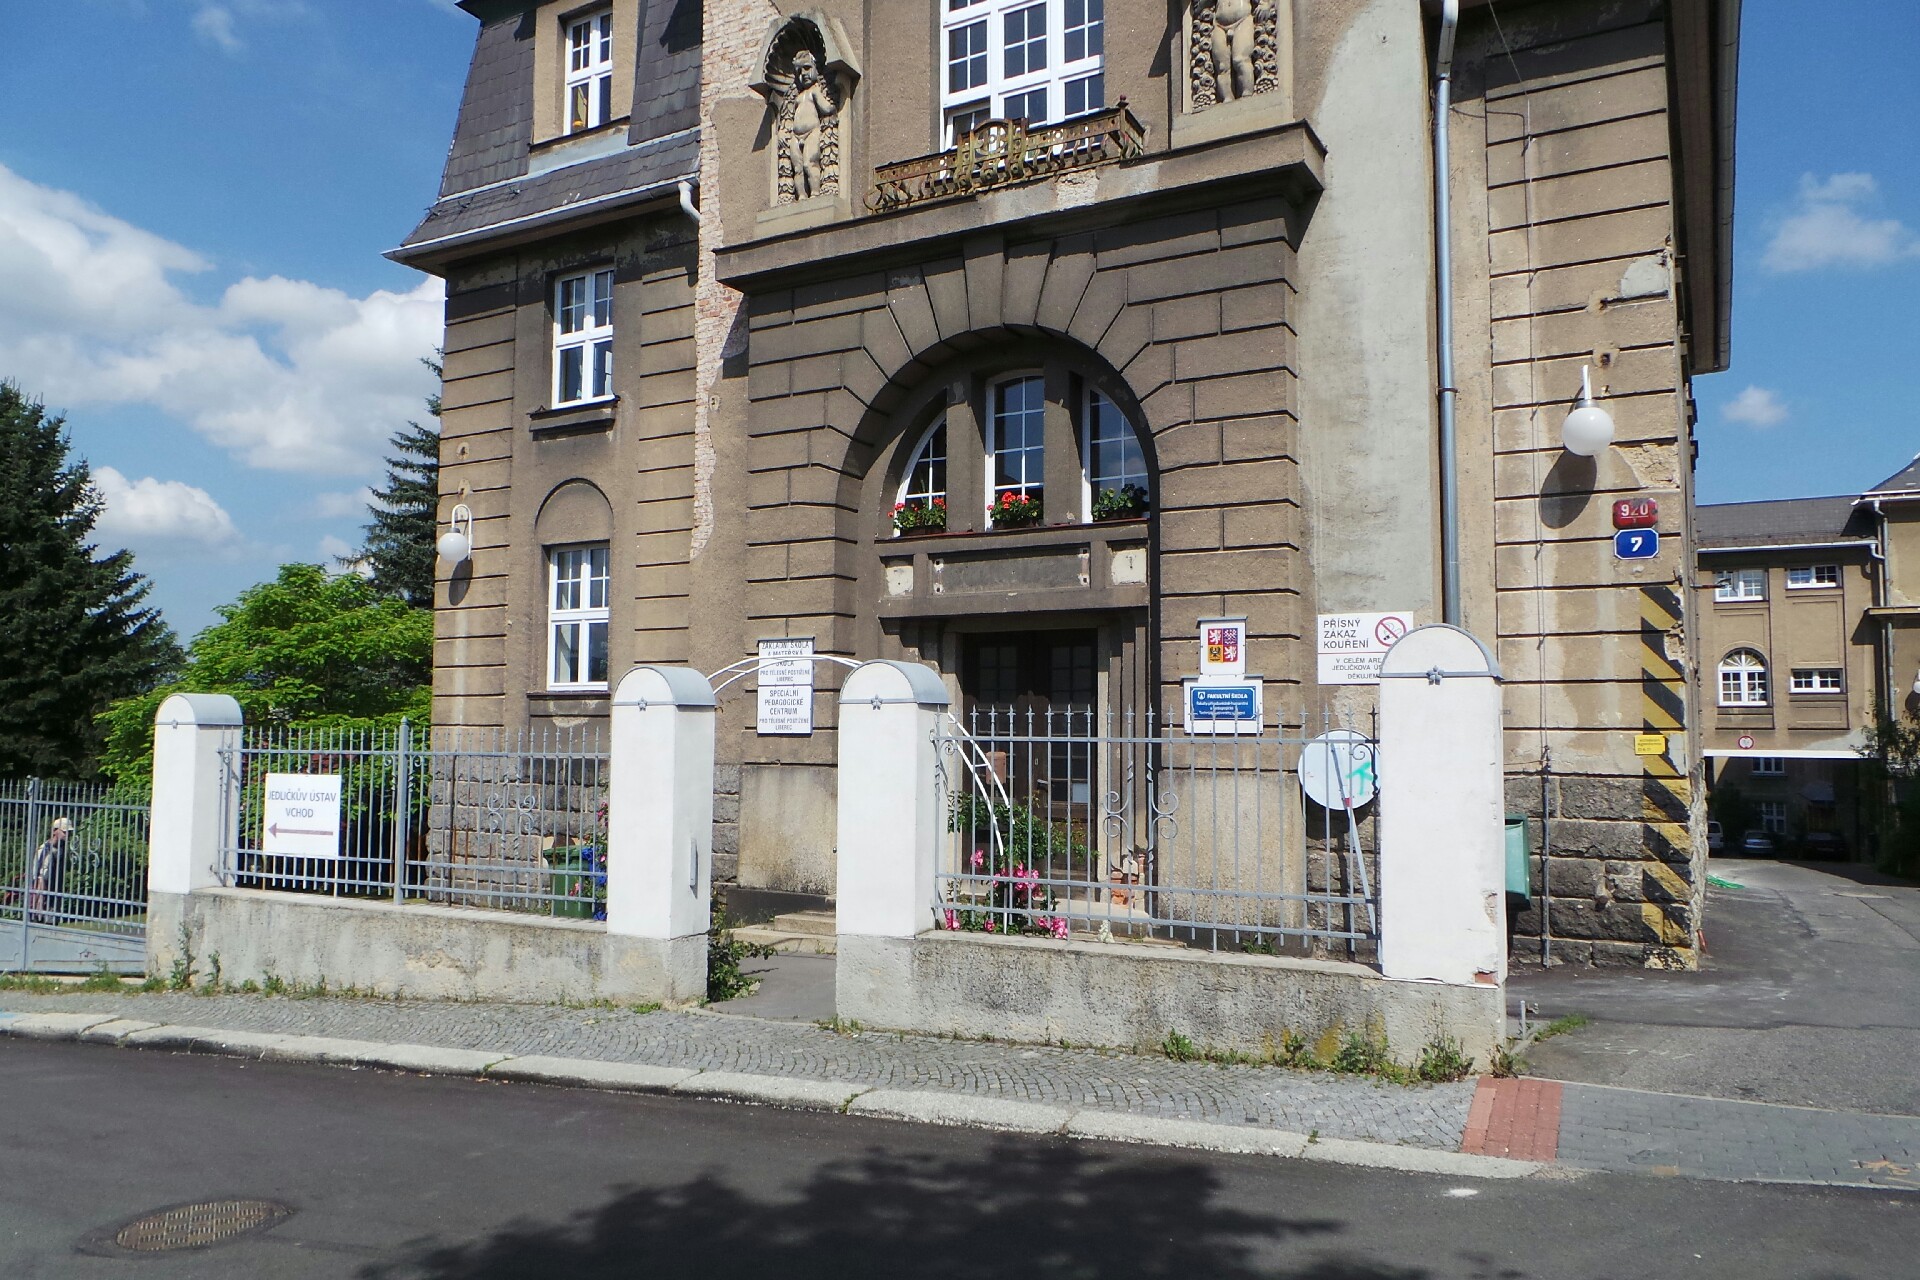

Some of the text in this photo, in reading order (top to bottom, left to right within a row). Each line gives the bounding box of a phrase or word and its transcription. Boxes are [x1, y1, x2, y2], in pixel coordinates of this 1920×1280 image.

[1621, 504, 1648, 516] 920
[1631, 536, 1642, 552] 7
[1324, 618, 1360, 628] PŘÍSNÝ
[1324, 628, 1356, 638] ZÁKAZ
[762, 640, 809, 649] ZÁKLADNÍ ŠKOLA
[1324, 638, 1368, 648] KOUŘENÍ
[770, 688, 799, 697] SPECIÁLNÍ
[765, 697, 804, 706] PEDAGOGICKÉ
[269, 788, 336, 802] JEDLIČKŮV ÚSTAV
[286, 808, 313, 818] VCHOD
